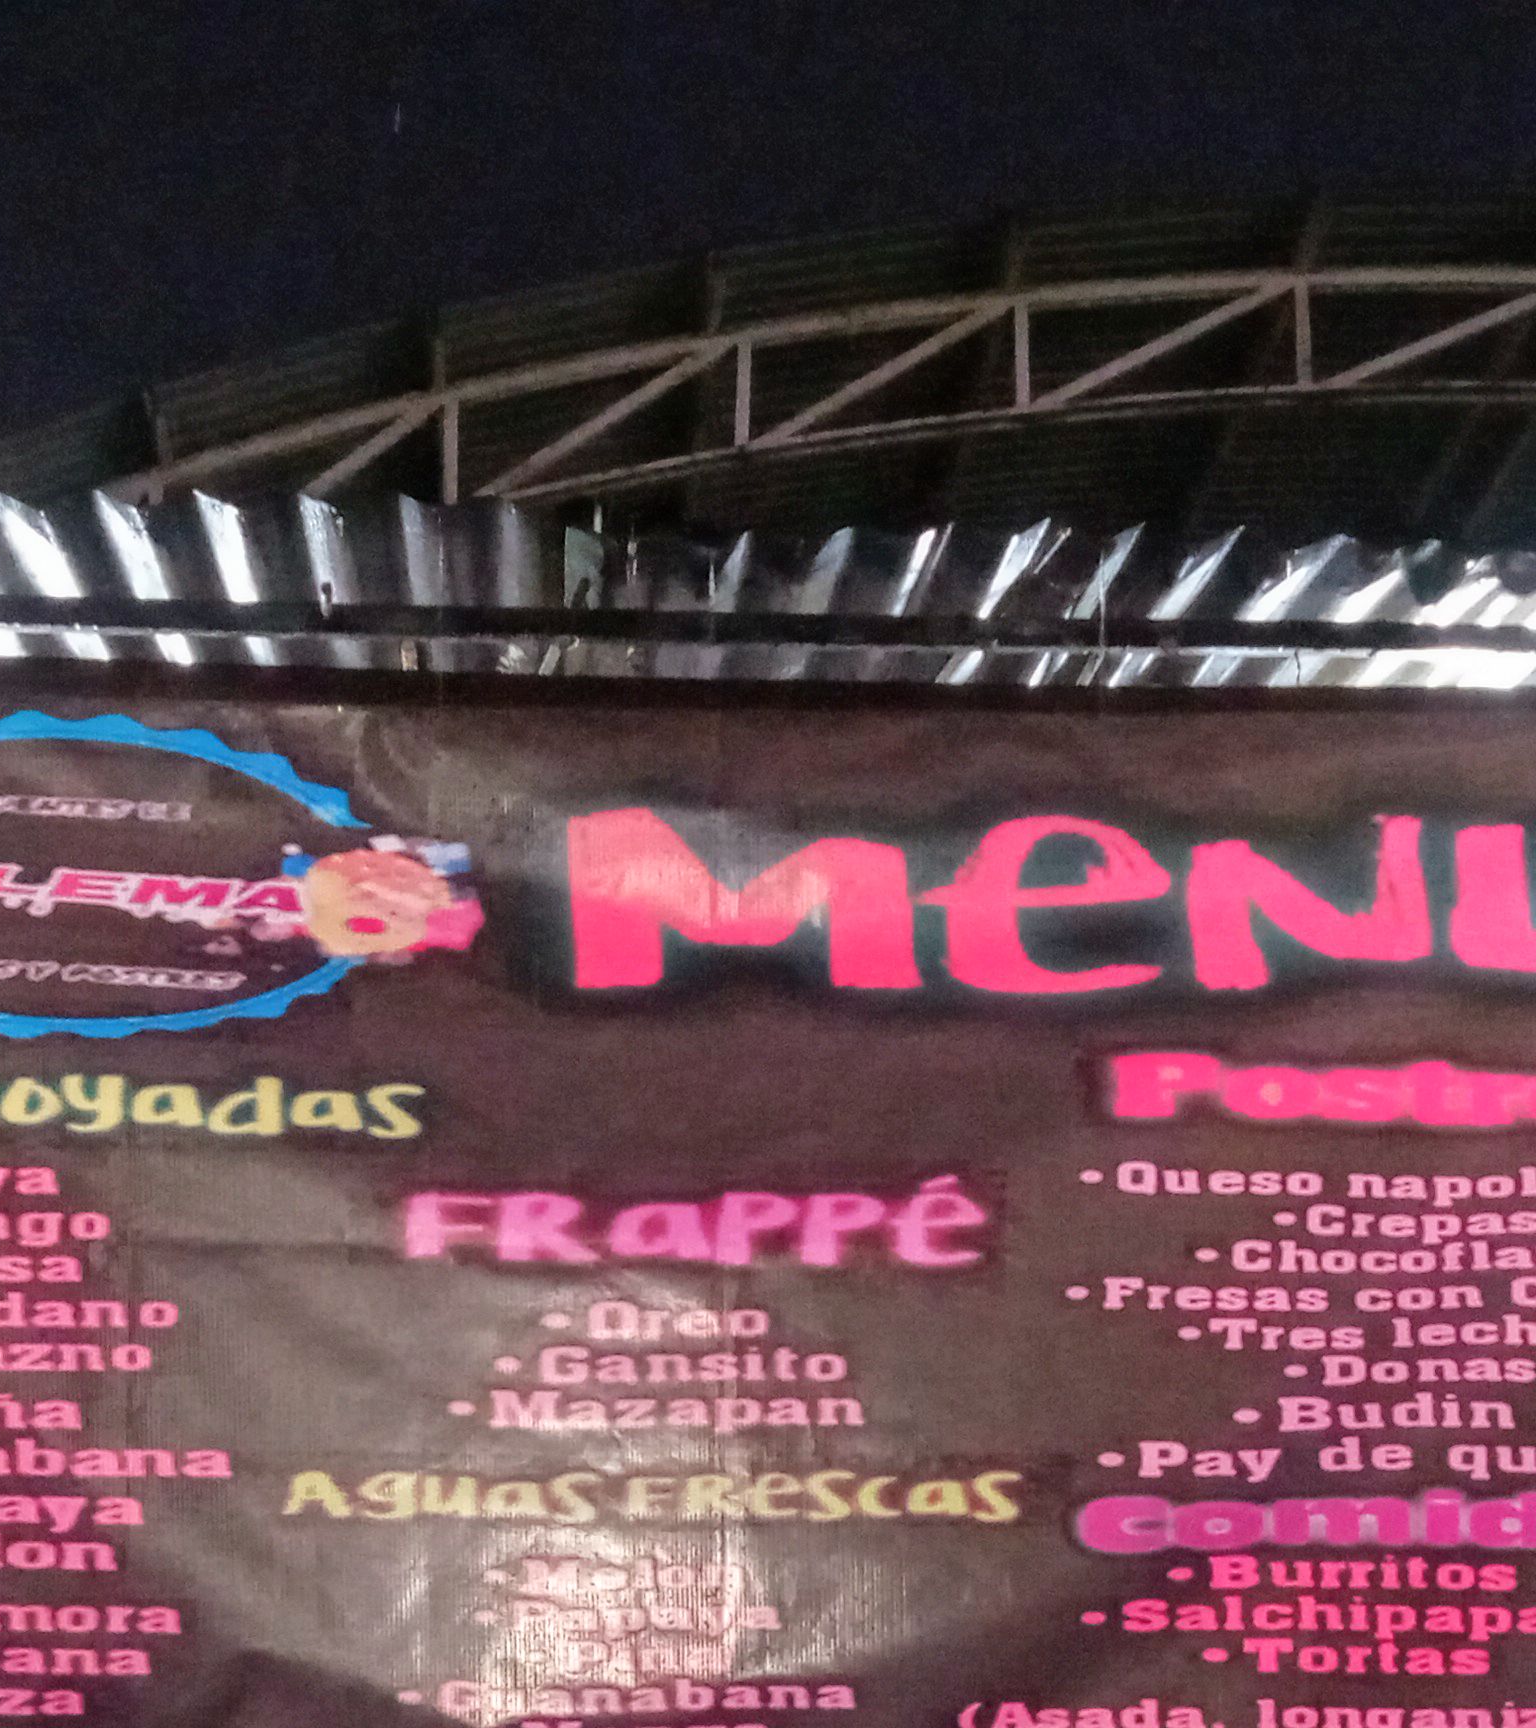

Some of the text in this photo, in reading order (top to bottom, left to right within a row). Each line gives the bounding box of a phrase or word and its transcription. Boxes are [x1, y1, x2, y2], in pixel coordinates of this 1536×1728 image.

[1115, 1161, 1324, 1199] Queso
[1102, 1276, 1330, 1314] Fresas
[1354, 1283, 1485, 1313] con
[585, 1299, 772, 1341] Oreo
[1208, 1317, 1365, 1352] Tres
[537, 1347, 850, 1386] Gansito
[488, 1389, 865, 1435] Mazapan
[1278, 1396, 1517, 1434] Budin
[1136, 1442, 1282, 1483] Pay
[1317, 1438, 1414, 1473] de
[1208, 1555, 1520, 1593] Burritos
[1243, 1638, 1493, 1677] Tortas
